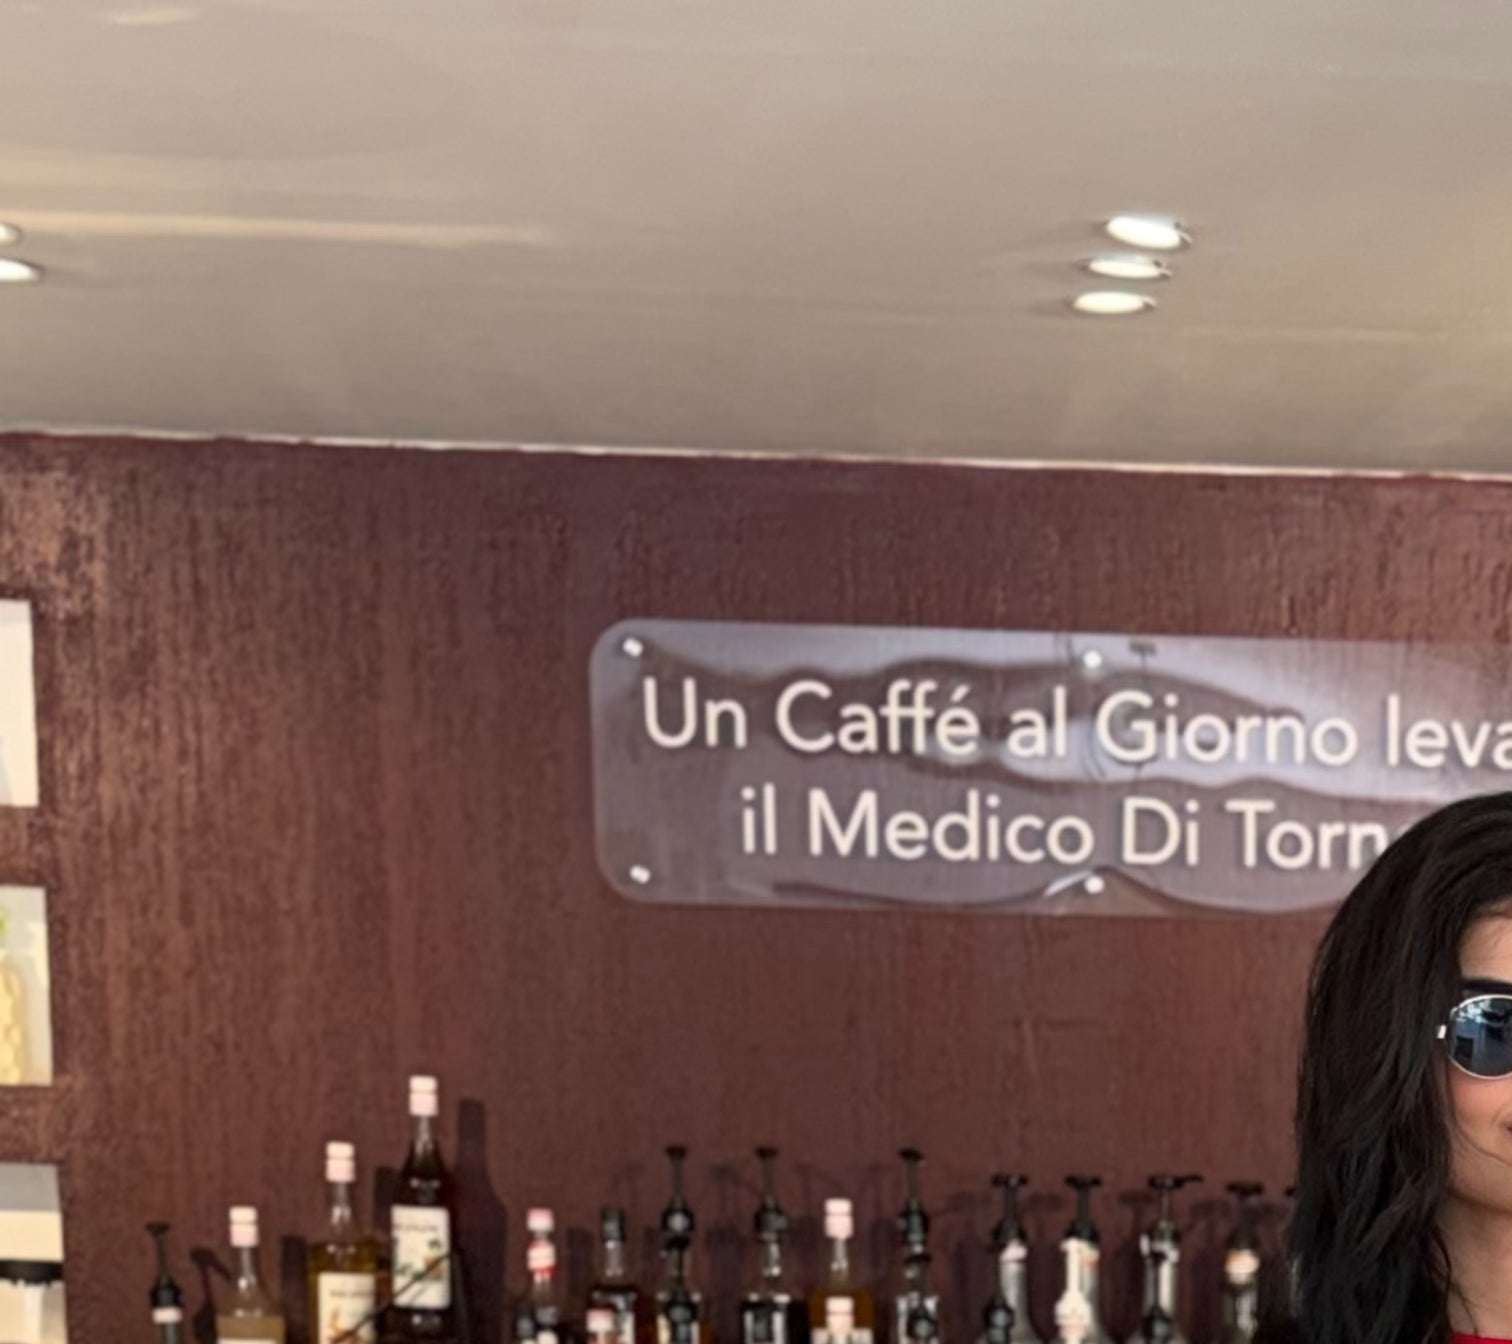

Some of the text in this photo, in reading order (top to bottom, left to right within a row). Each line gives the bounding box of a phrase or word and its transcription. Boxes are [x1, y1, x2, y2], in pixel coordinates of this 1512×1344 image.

[643, 676, 747, 748] Un
[775, 678, 981, 755] Caffé
[1006, 684, 1068, 758] al
[1095, 689, 1359, 766] Giorno
[740, 781, 1405, 870] il Medico Di Torn
